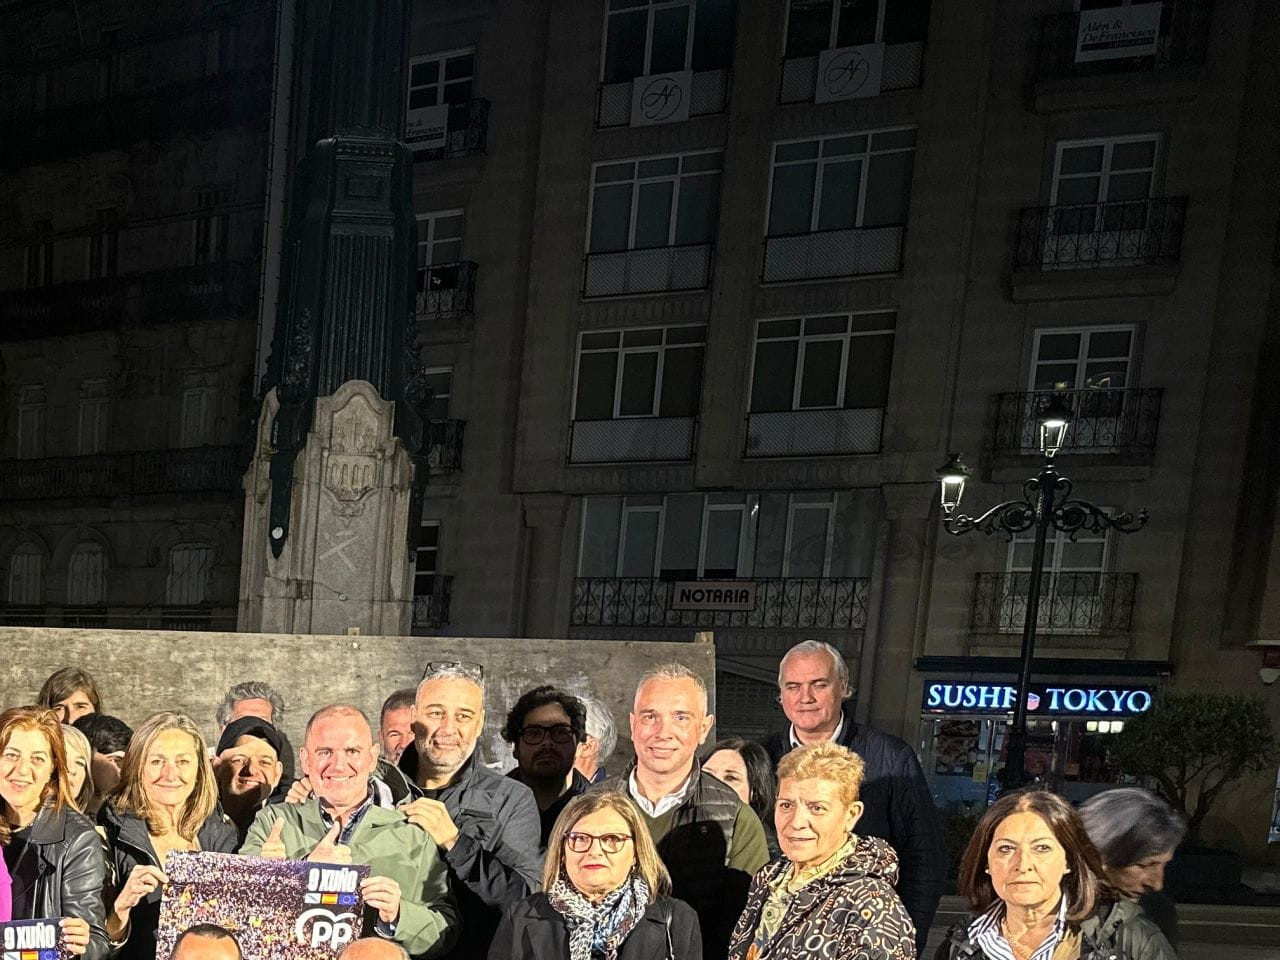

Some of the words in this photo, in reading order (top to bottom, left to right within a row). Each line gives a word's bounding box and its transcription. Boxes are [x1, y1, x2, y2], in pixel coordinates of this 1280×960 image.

[680, 589, 749, 603] NOTARIA
[1046, 688, 1152, 713] TOKYO
[307, 868, 319, 892] 9
[319, 867, 358, 892] XUÑO
[4, 927, 14, 949] 9
[16, 922, 55, 948] XUÑO
